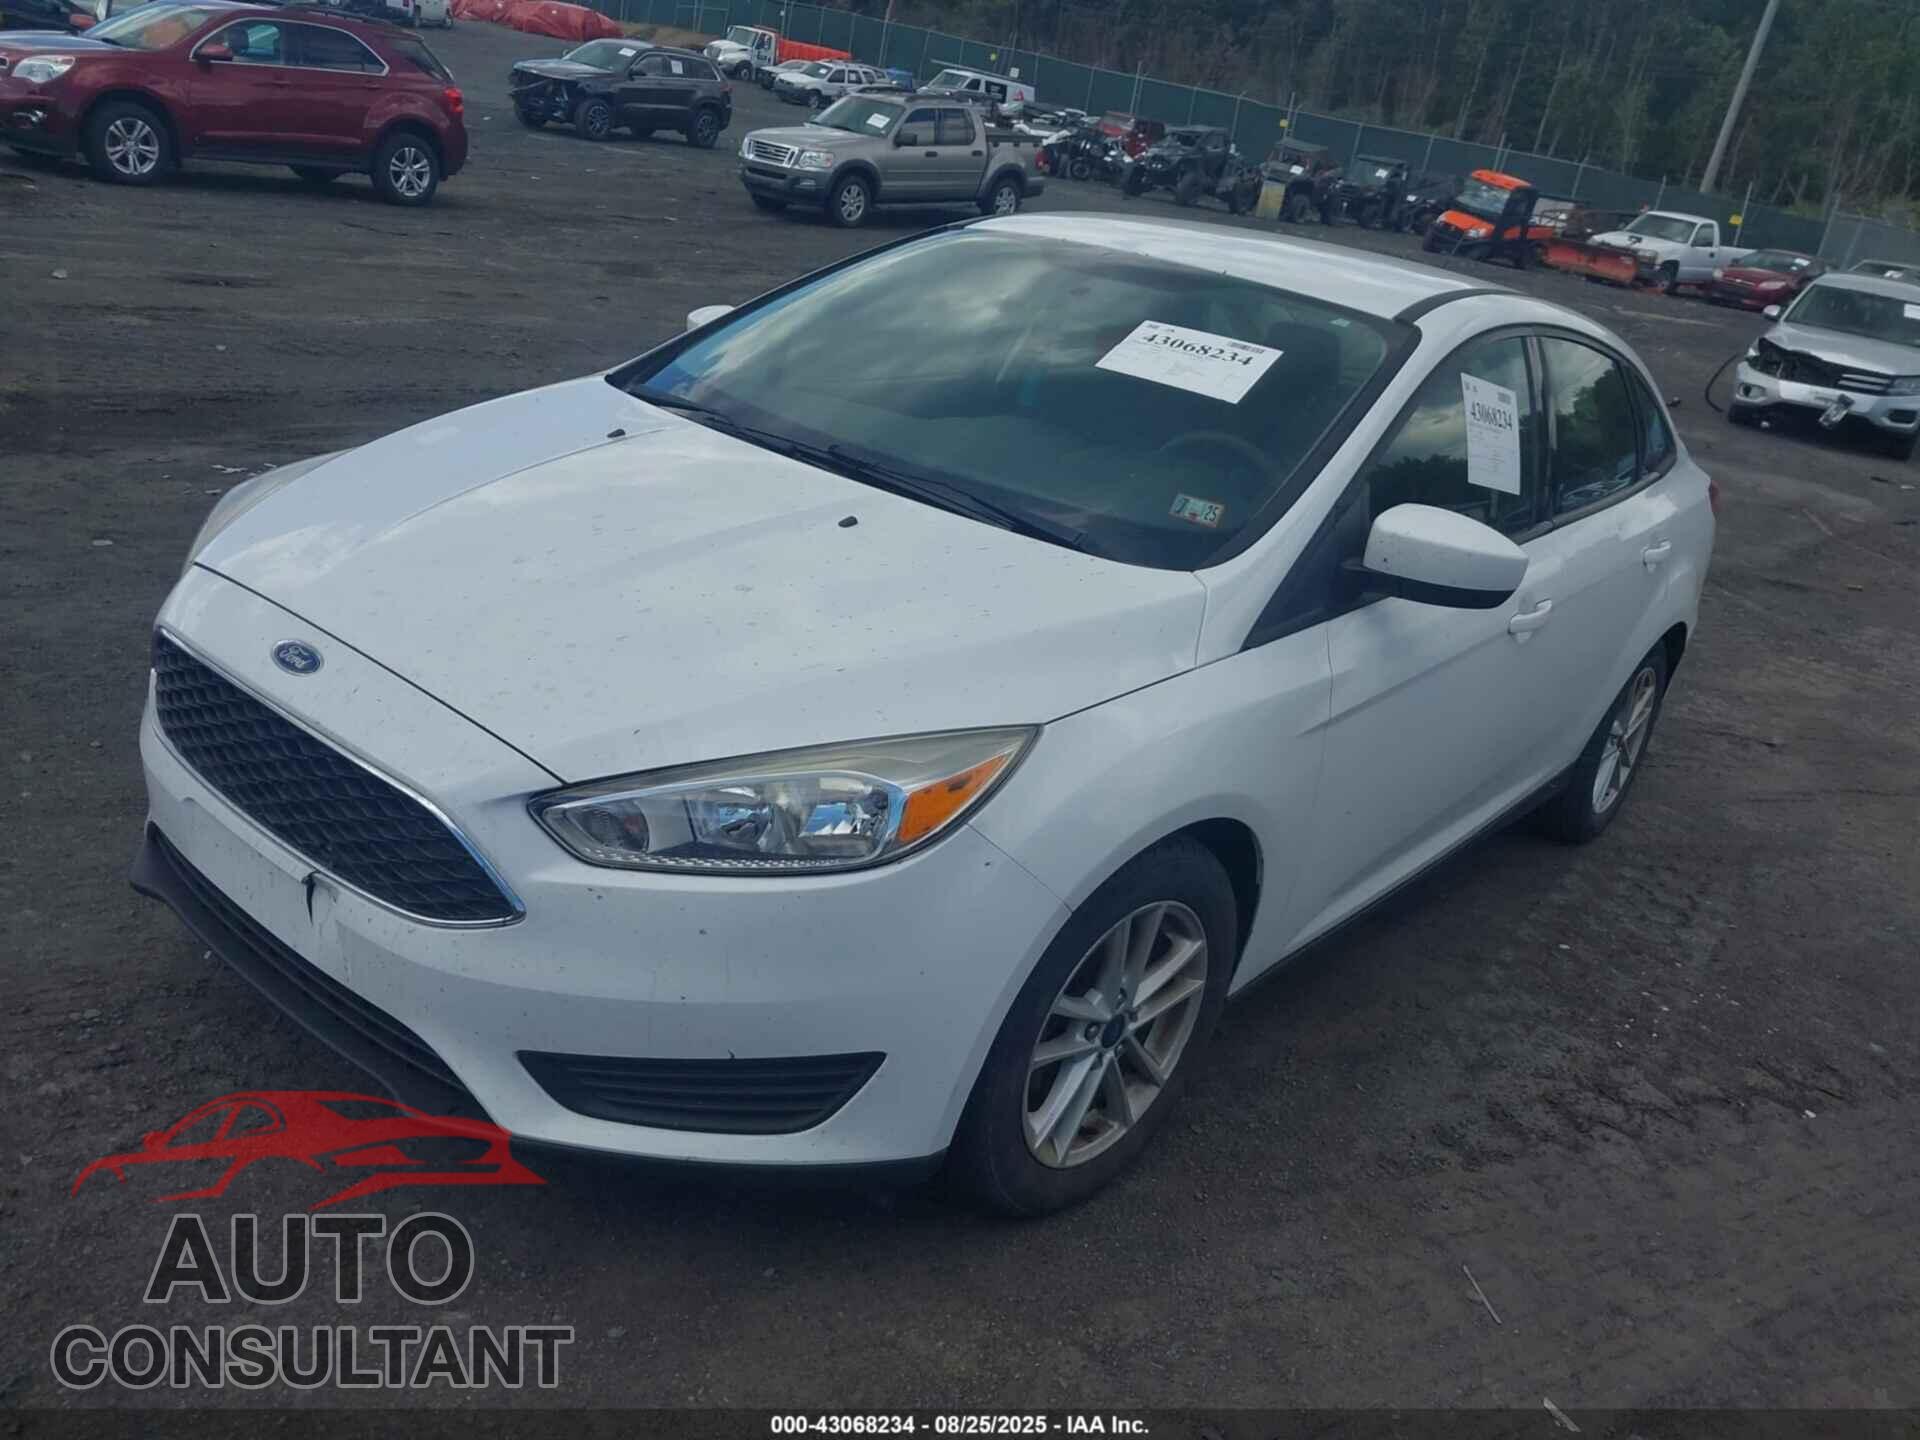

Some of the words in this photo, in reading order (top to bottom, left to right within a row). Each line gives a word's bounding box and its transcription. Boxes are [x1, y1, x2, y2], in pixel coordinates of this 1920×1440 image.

[1142, 333, 1254, 366] 43068234
[1471, 401, 1513, 431] 43068234
[279, 645, 313, 669] Ford
